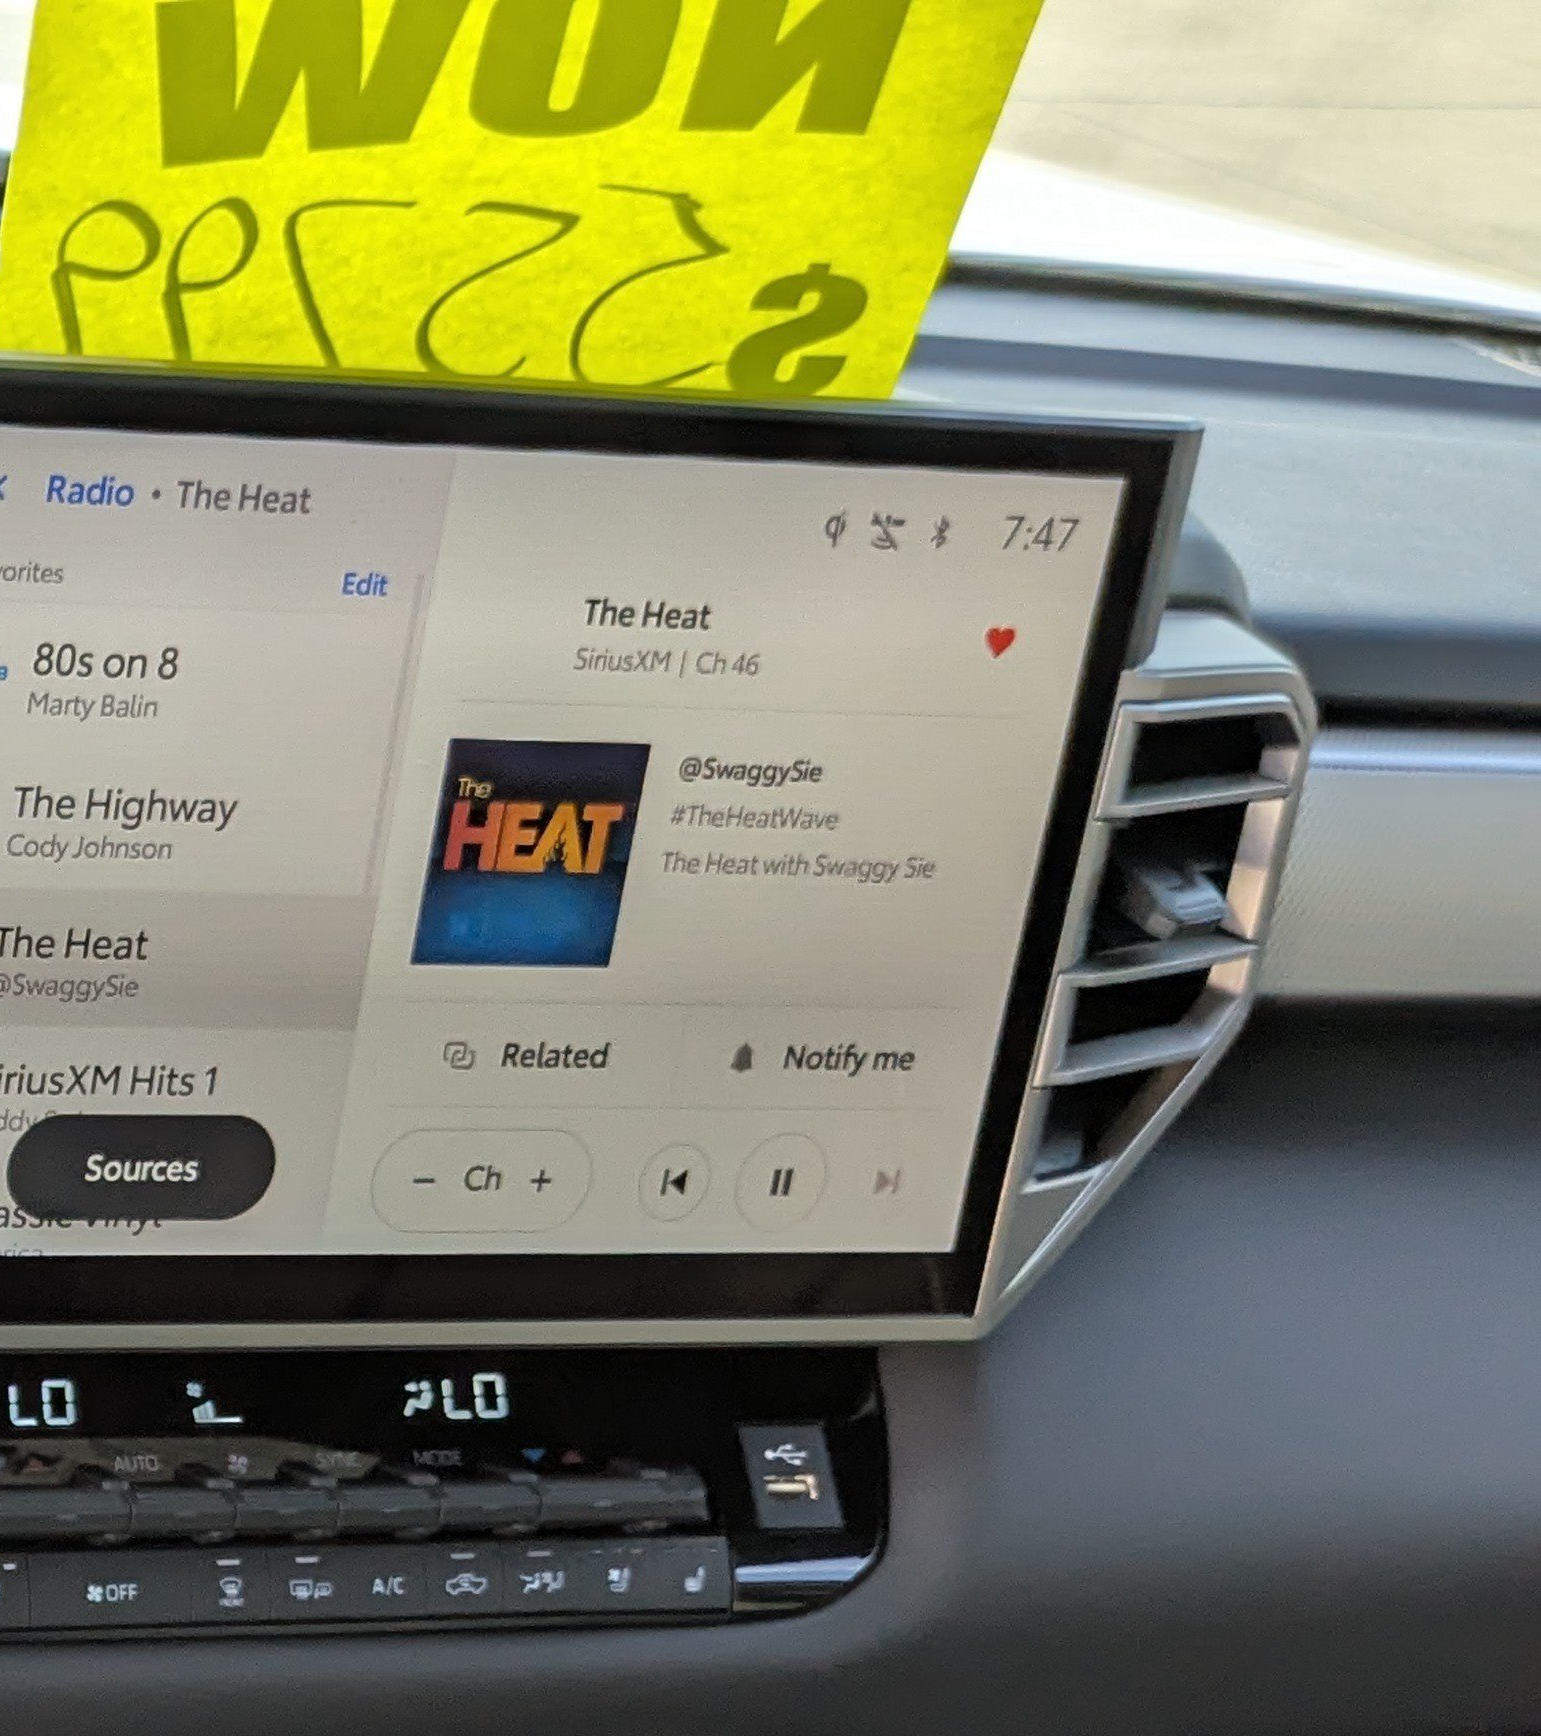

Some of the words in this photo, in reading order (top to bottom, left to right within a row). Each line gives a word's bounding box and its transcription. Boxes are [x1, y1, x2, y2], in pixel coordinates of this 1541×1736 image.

[46, 475, 134, 506] Radio
[177, 481, 230, 512] The
[238, 483, 312, 515] Heat
[1001, 516, 1080, 551] 7:47
[342, 572, 388, 597] Edit
[584, 598, 635, 627] The
[642, 600, 711, 630] Heat
[33, 643, 92, 678] 80s
[103, 653, 147, 679] on
[157, 647, 179, 680] 8
[573, 647, 670, 674] SiriusXM
[696, 652, 727, 675] Ch
[731, 653, 759, 677] 46
[27, 692, 95, 721] Marty
[100, 693, 158, 719] Balin
[679, 758, 822, 787] @SwaggySie
[458, 777, 491, 799] The
[15, 787, 75, 820] The
[85, 789, 238, 830] Highway
[670, 805, 839, 832] #TheHeatWave
[7, 834, 67, 863] Cody
[71, 835, 172, 861] Johnson
[442, 801, 623, 875] HEAT
[662, 852, 700, 876] The
[706, 854, 755, 877] Heat
[760, 854, 809, 878] with
[814, 856, 899, 883] Swaggy
[904, 857, 936, 880] Sie
[64, 928, 148, 961] Heat
[501, 1042, 609, 1070] Related
[783, 1044, 866, 1077] Notify
[872, 1051, 915, 1072] me
[129, 1064, 194, 1096] Hits
[205, 1067, 219, 1095] 1
[84, 1152, 200, 1182] Sources
[464, 1166, 502, 1192] Ch
[115, 1456, 159, 1472] AUTO
[106, 1584, 138, 1601] OFF
[371, 1576, 406, 1596] A/C
